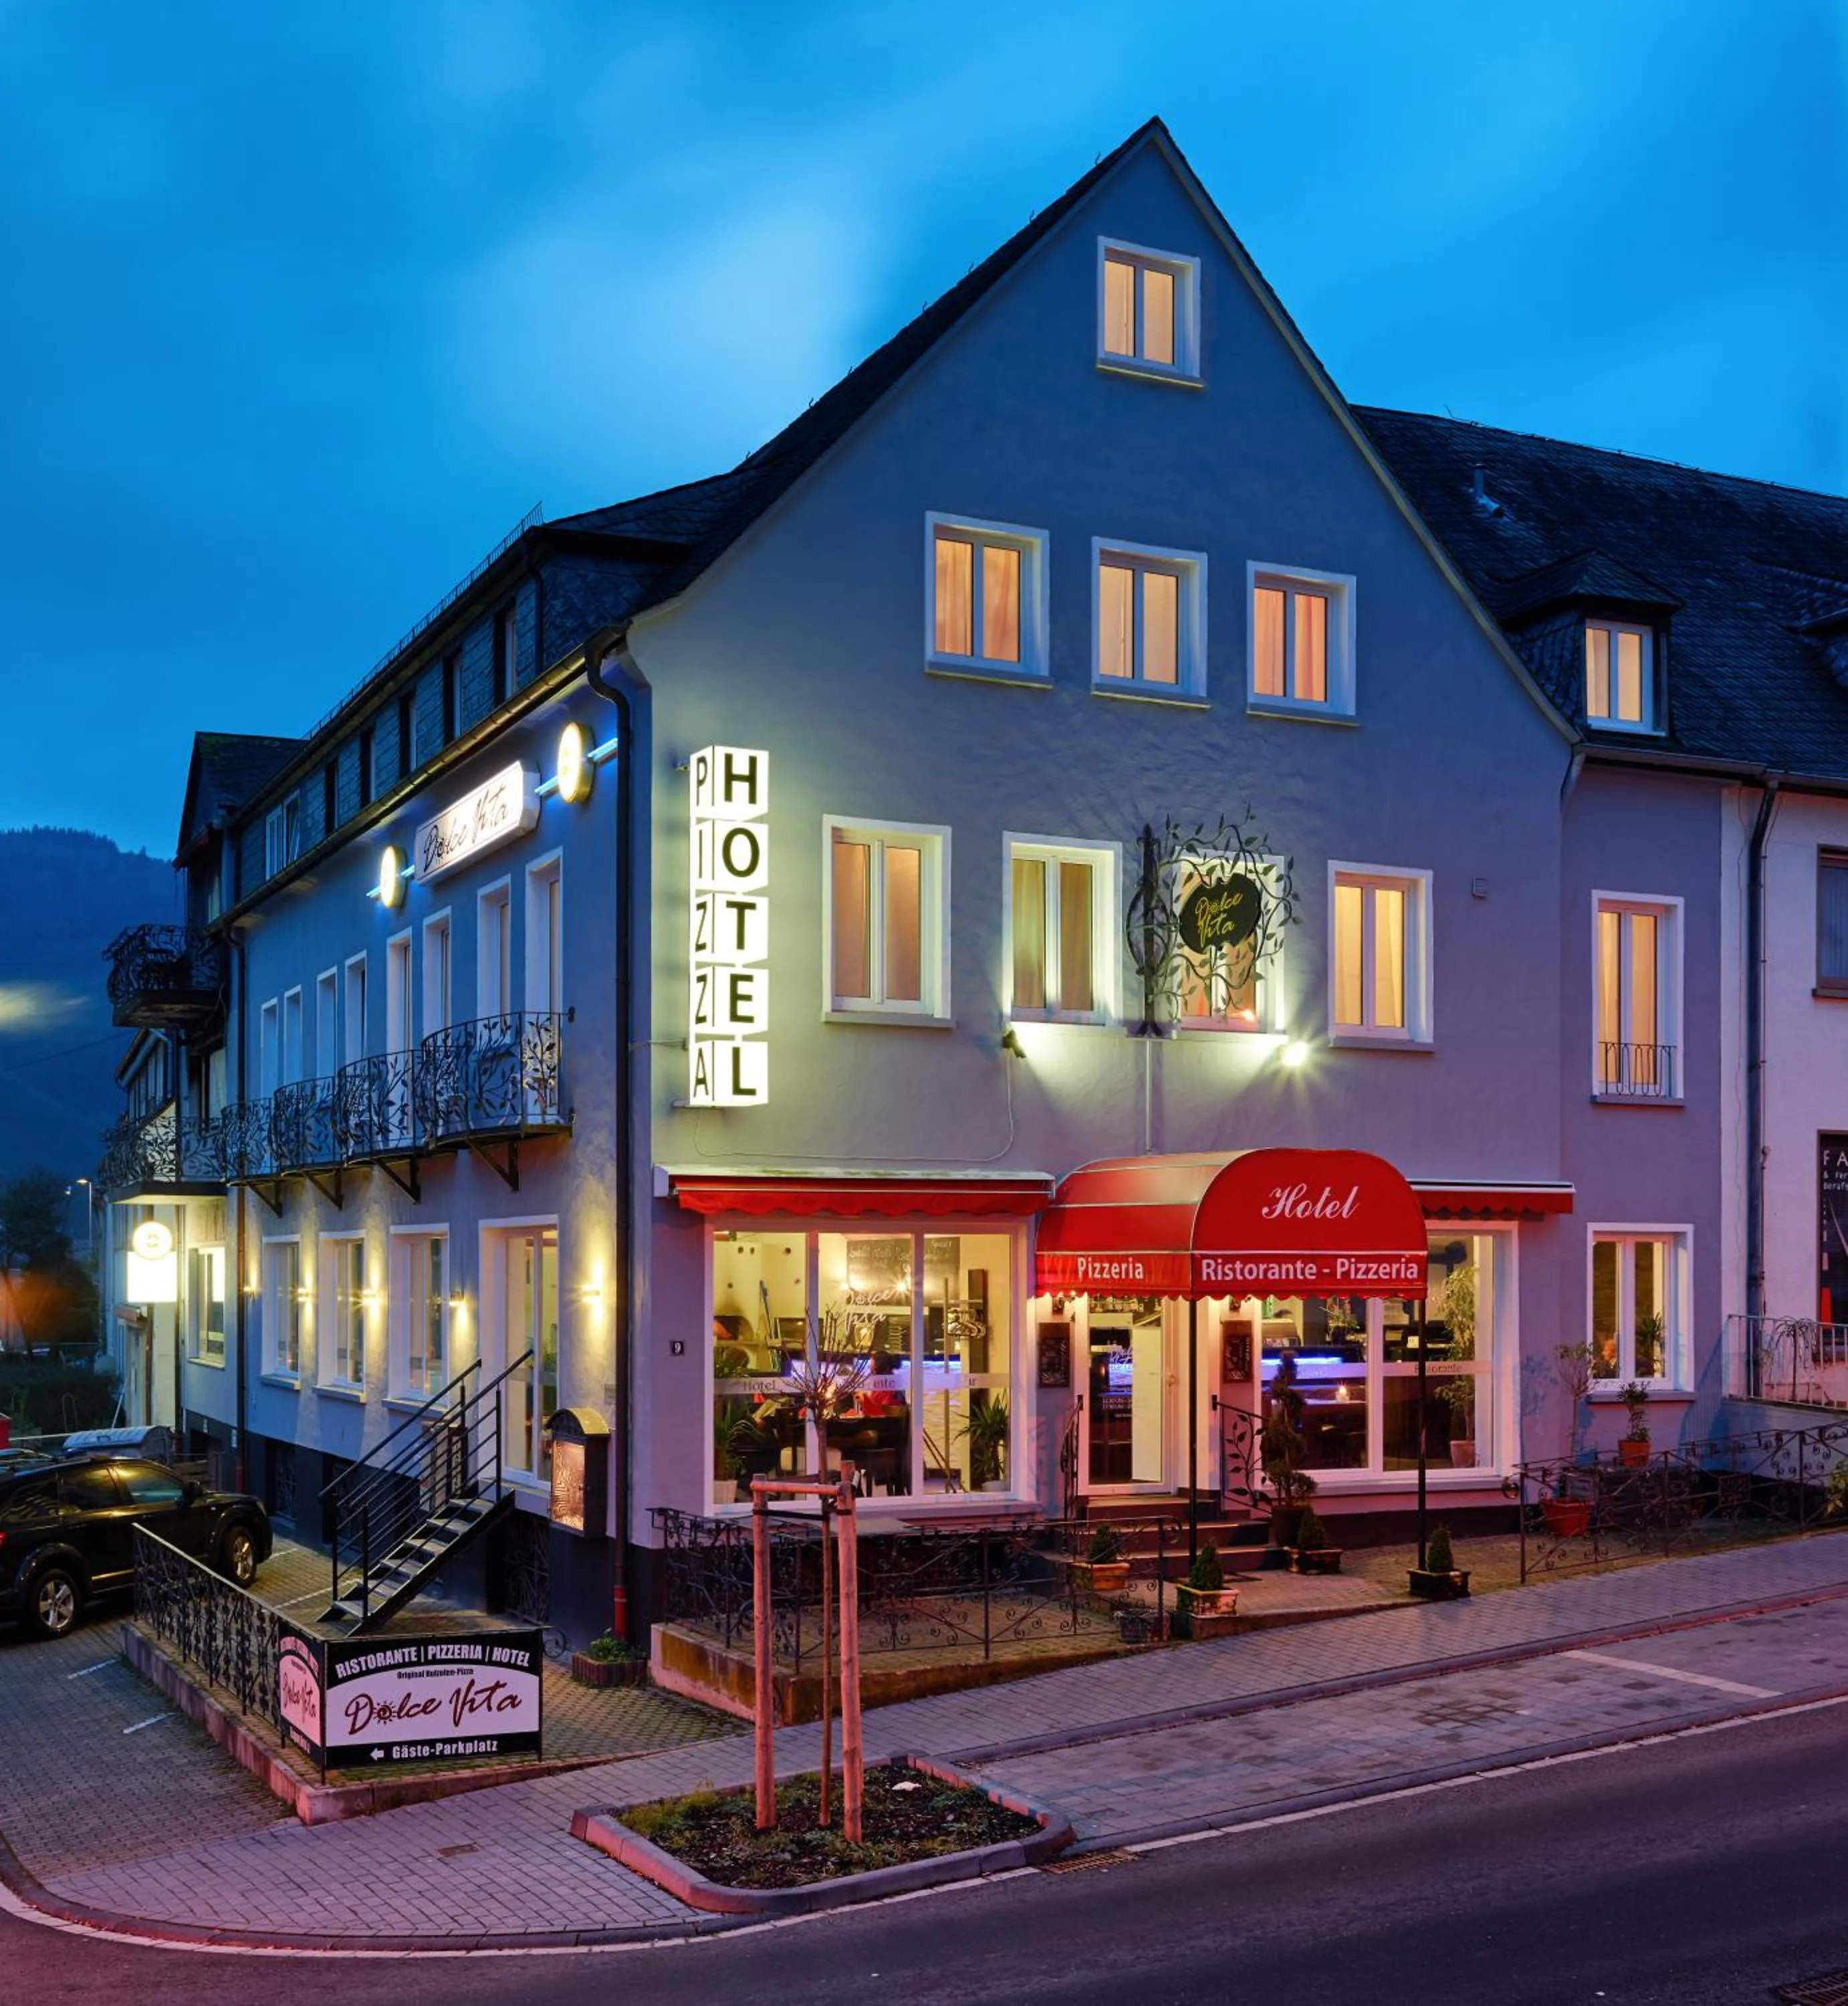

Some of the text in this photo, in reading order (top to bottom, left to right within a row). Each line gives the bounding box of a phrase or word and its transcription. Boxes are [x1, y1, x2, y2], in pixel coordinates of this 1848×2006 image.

[423, 784, 509, 873] Dolce Vita
[1195, 891, 1243, 915] Dolce
[693, 756, 709, 1097] PIZZA
[722, 753, 760, 1097] HOTEL
[1197, 912, 1235, 948] Vita
[1262, 1183, 1359, 1219] Hotel
[1077, 1256, 1144, 1280] Pizzeria
[1201, 1258, 1317, 1281] Ristorante
[1336, 1257, 1418, 1280] Pizzeria
[673, 1342, 681, 1353] 9
[335, 1646, 418, 1679] RISTORANTE
[427, 1644, 483, 1660] PIZZERIA
[491, 1646, 531, 1667] HOTEL
[396, 1669, 425, 1680] Original
[344, 1678, 522, 1735] Dolce Vita
[392, 1739, 498, 1760] Gäste-Parkplatz
